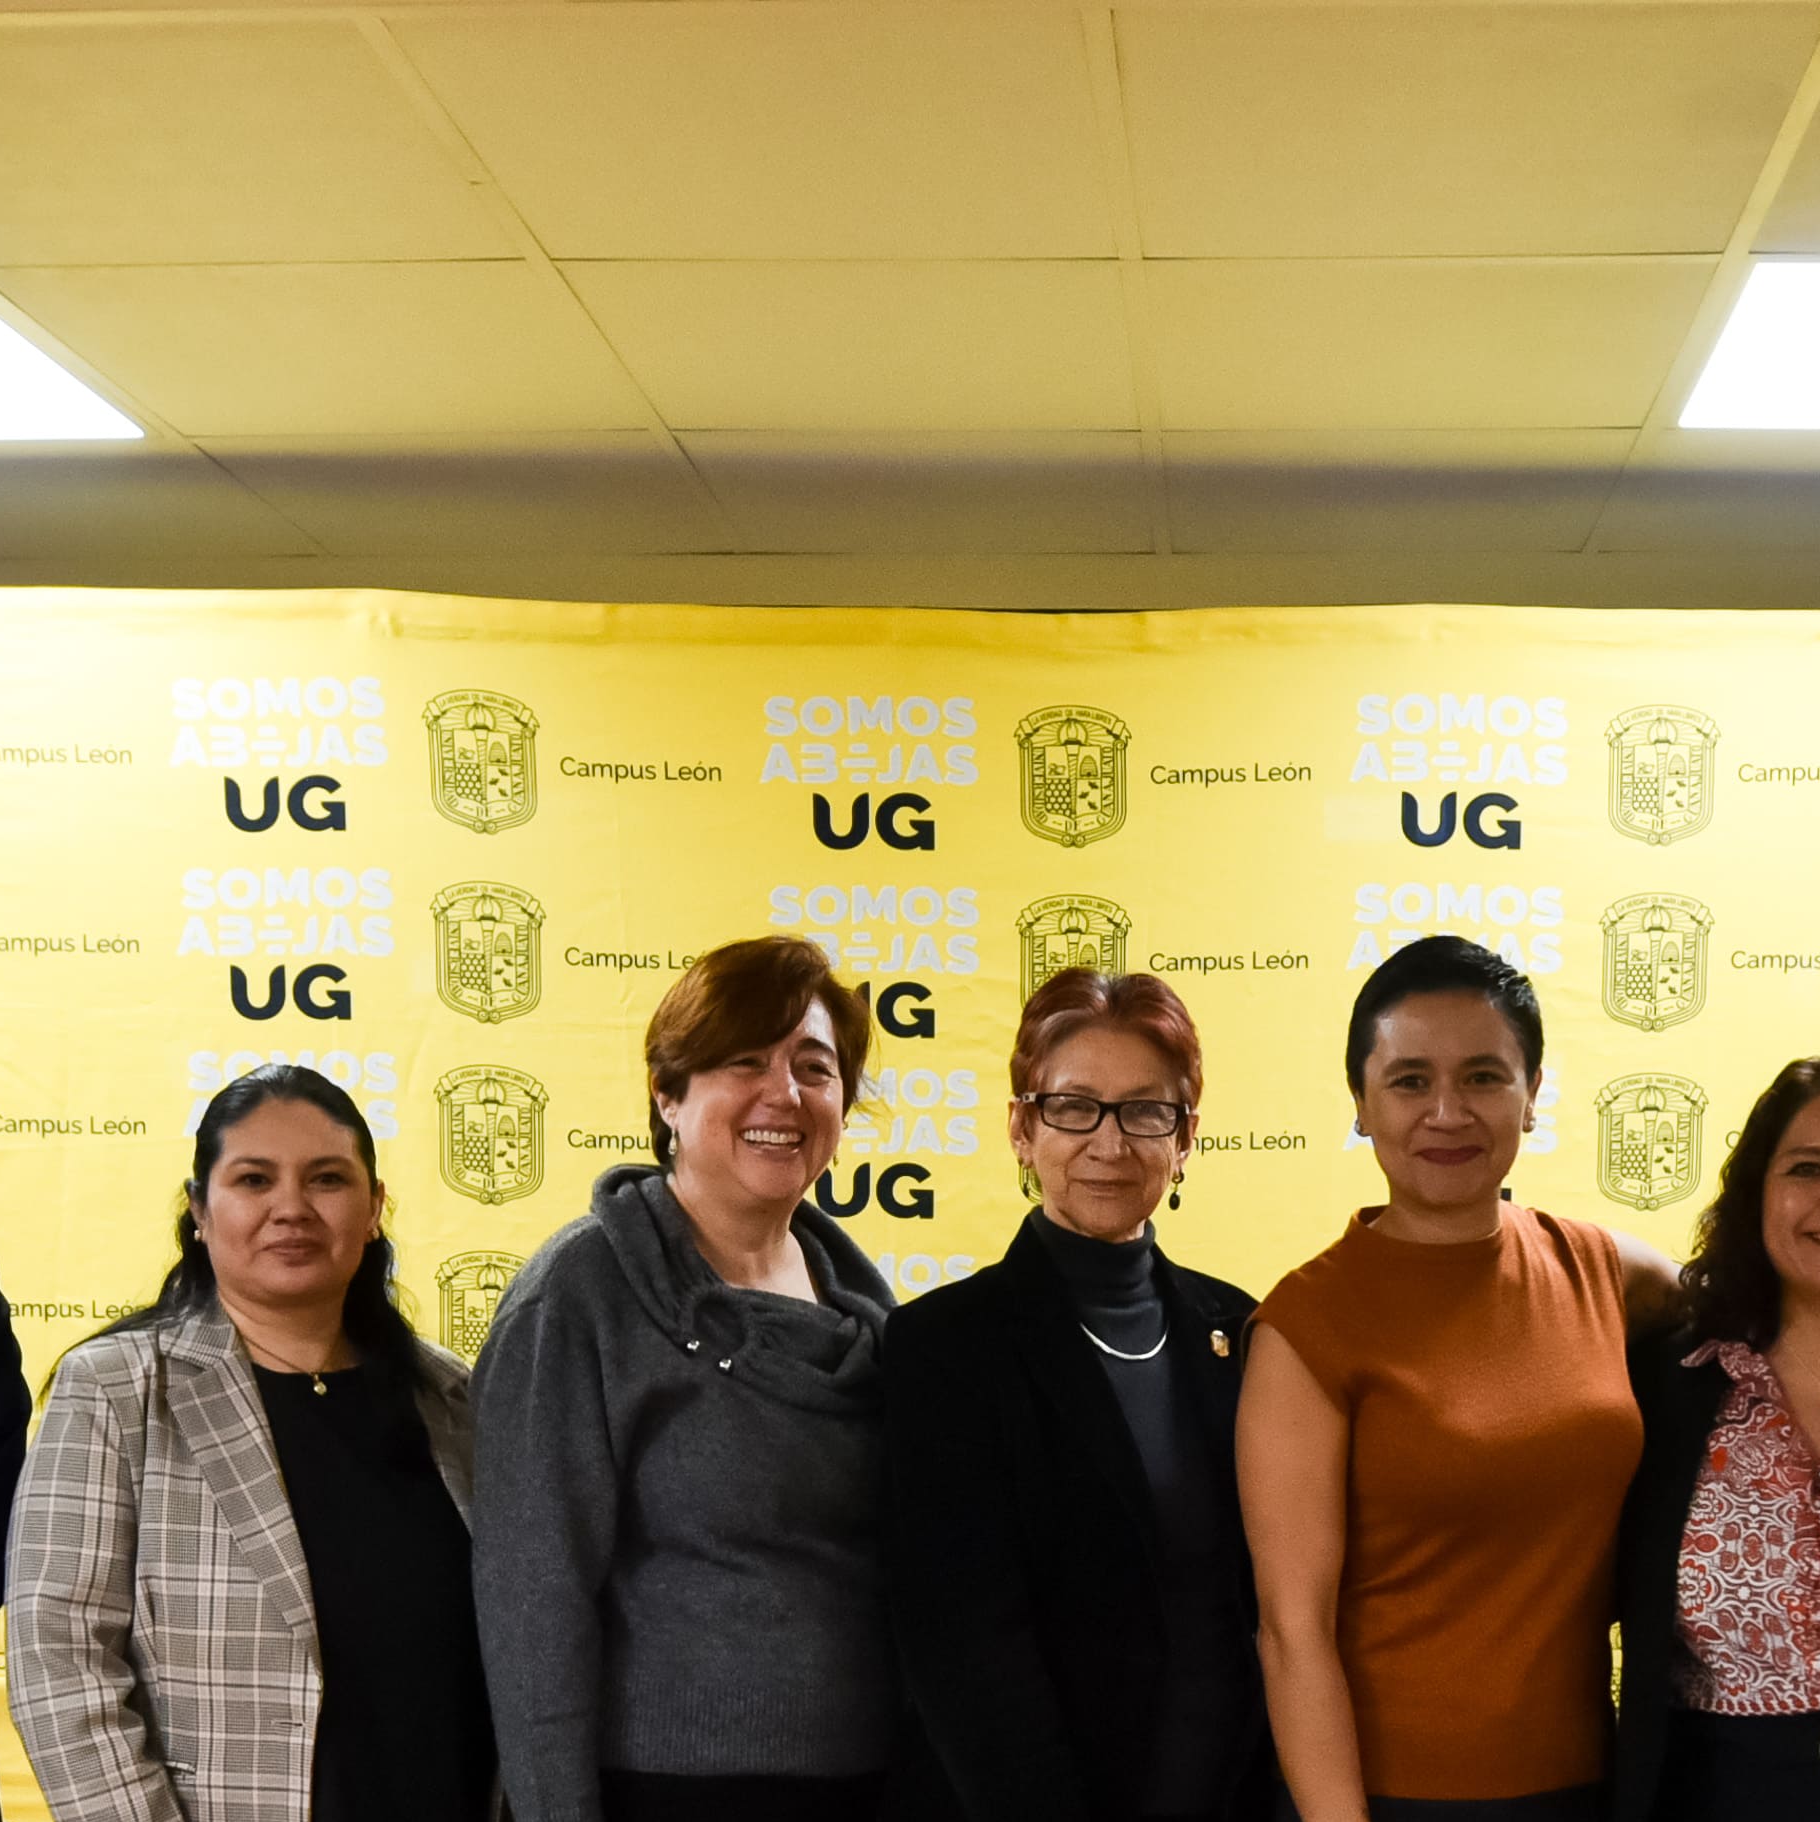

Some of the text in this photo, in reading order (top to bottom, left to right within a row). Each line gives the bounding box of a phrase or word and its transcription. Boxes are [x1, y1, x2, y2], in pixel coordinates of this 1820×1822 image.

[169, 676, 385, 719] SOMOS
[763, 695, 977, 739] SOMOS
[1356, 693, 1569, 739] SOMOS
[75, 744, 132, 765] León
[560, 757, 722, 784] Campus León
[1150, 762, 1311, 789] Campus León
[225, 775, 346, 832] UG
[813, 793, 934, 850] UG
[1402, 792, 1521, 849] UG
[181, 867, 393, 910] SOMOS
[768, 885, 979, 928] SOMOS
[1354, 882, 1564, 928] SOMOS
[84, 934, 139, 953] León
[565, 947, 660, 973] Campus
[1149, 950, 1308, 976] Campus León
[231, 964, 351, 1020] UG
[90, 1116, 146, 1135] León
[567, 1129, 649, 1154] Campu
[1250, 1131, 1306, 1150] León
[815, 1162, 935, 1219] UG
[9, 1303, 85, 1322] ampus
